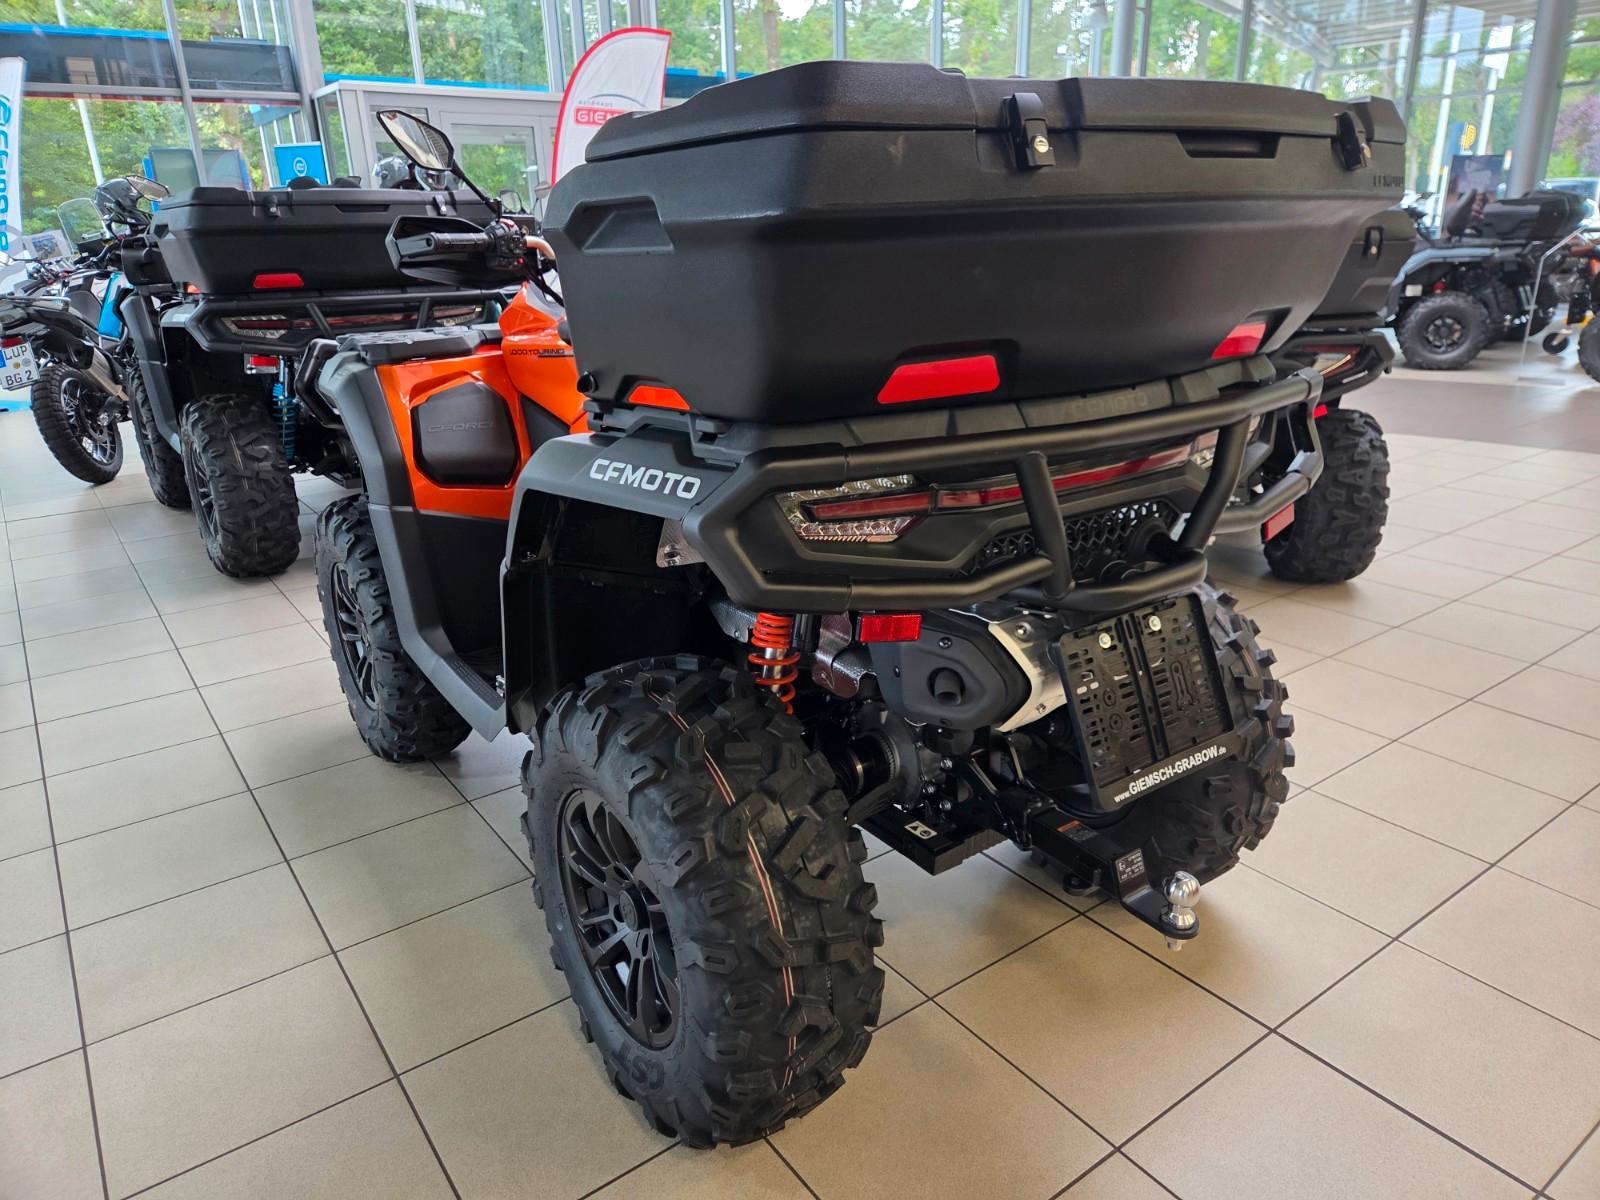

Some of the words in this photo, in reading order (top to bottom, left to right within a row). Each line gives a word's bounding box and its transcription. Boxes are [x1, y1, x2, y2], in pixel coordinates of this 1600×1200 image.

[3, 345, 27, 361] LUP
[5, 373, 23, 386] BG
[589, 458, 701, 500] CFMOTO
[1113, 745, 1227, 803] www.GIEMSCH-GRABOW.de
